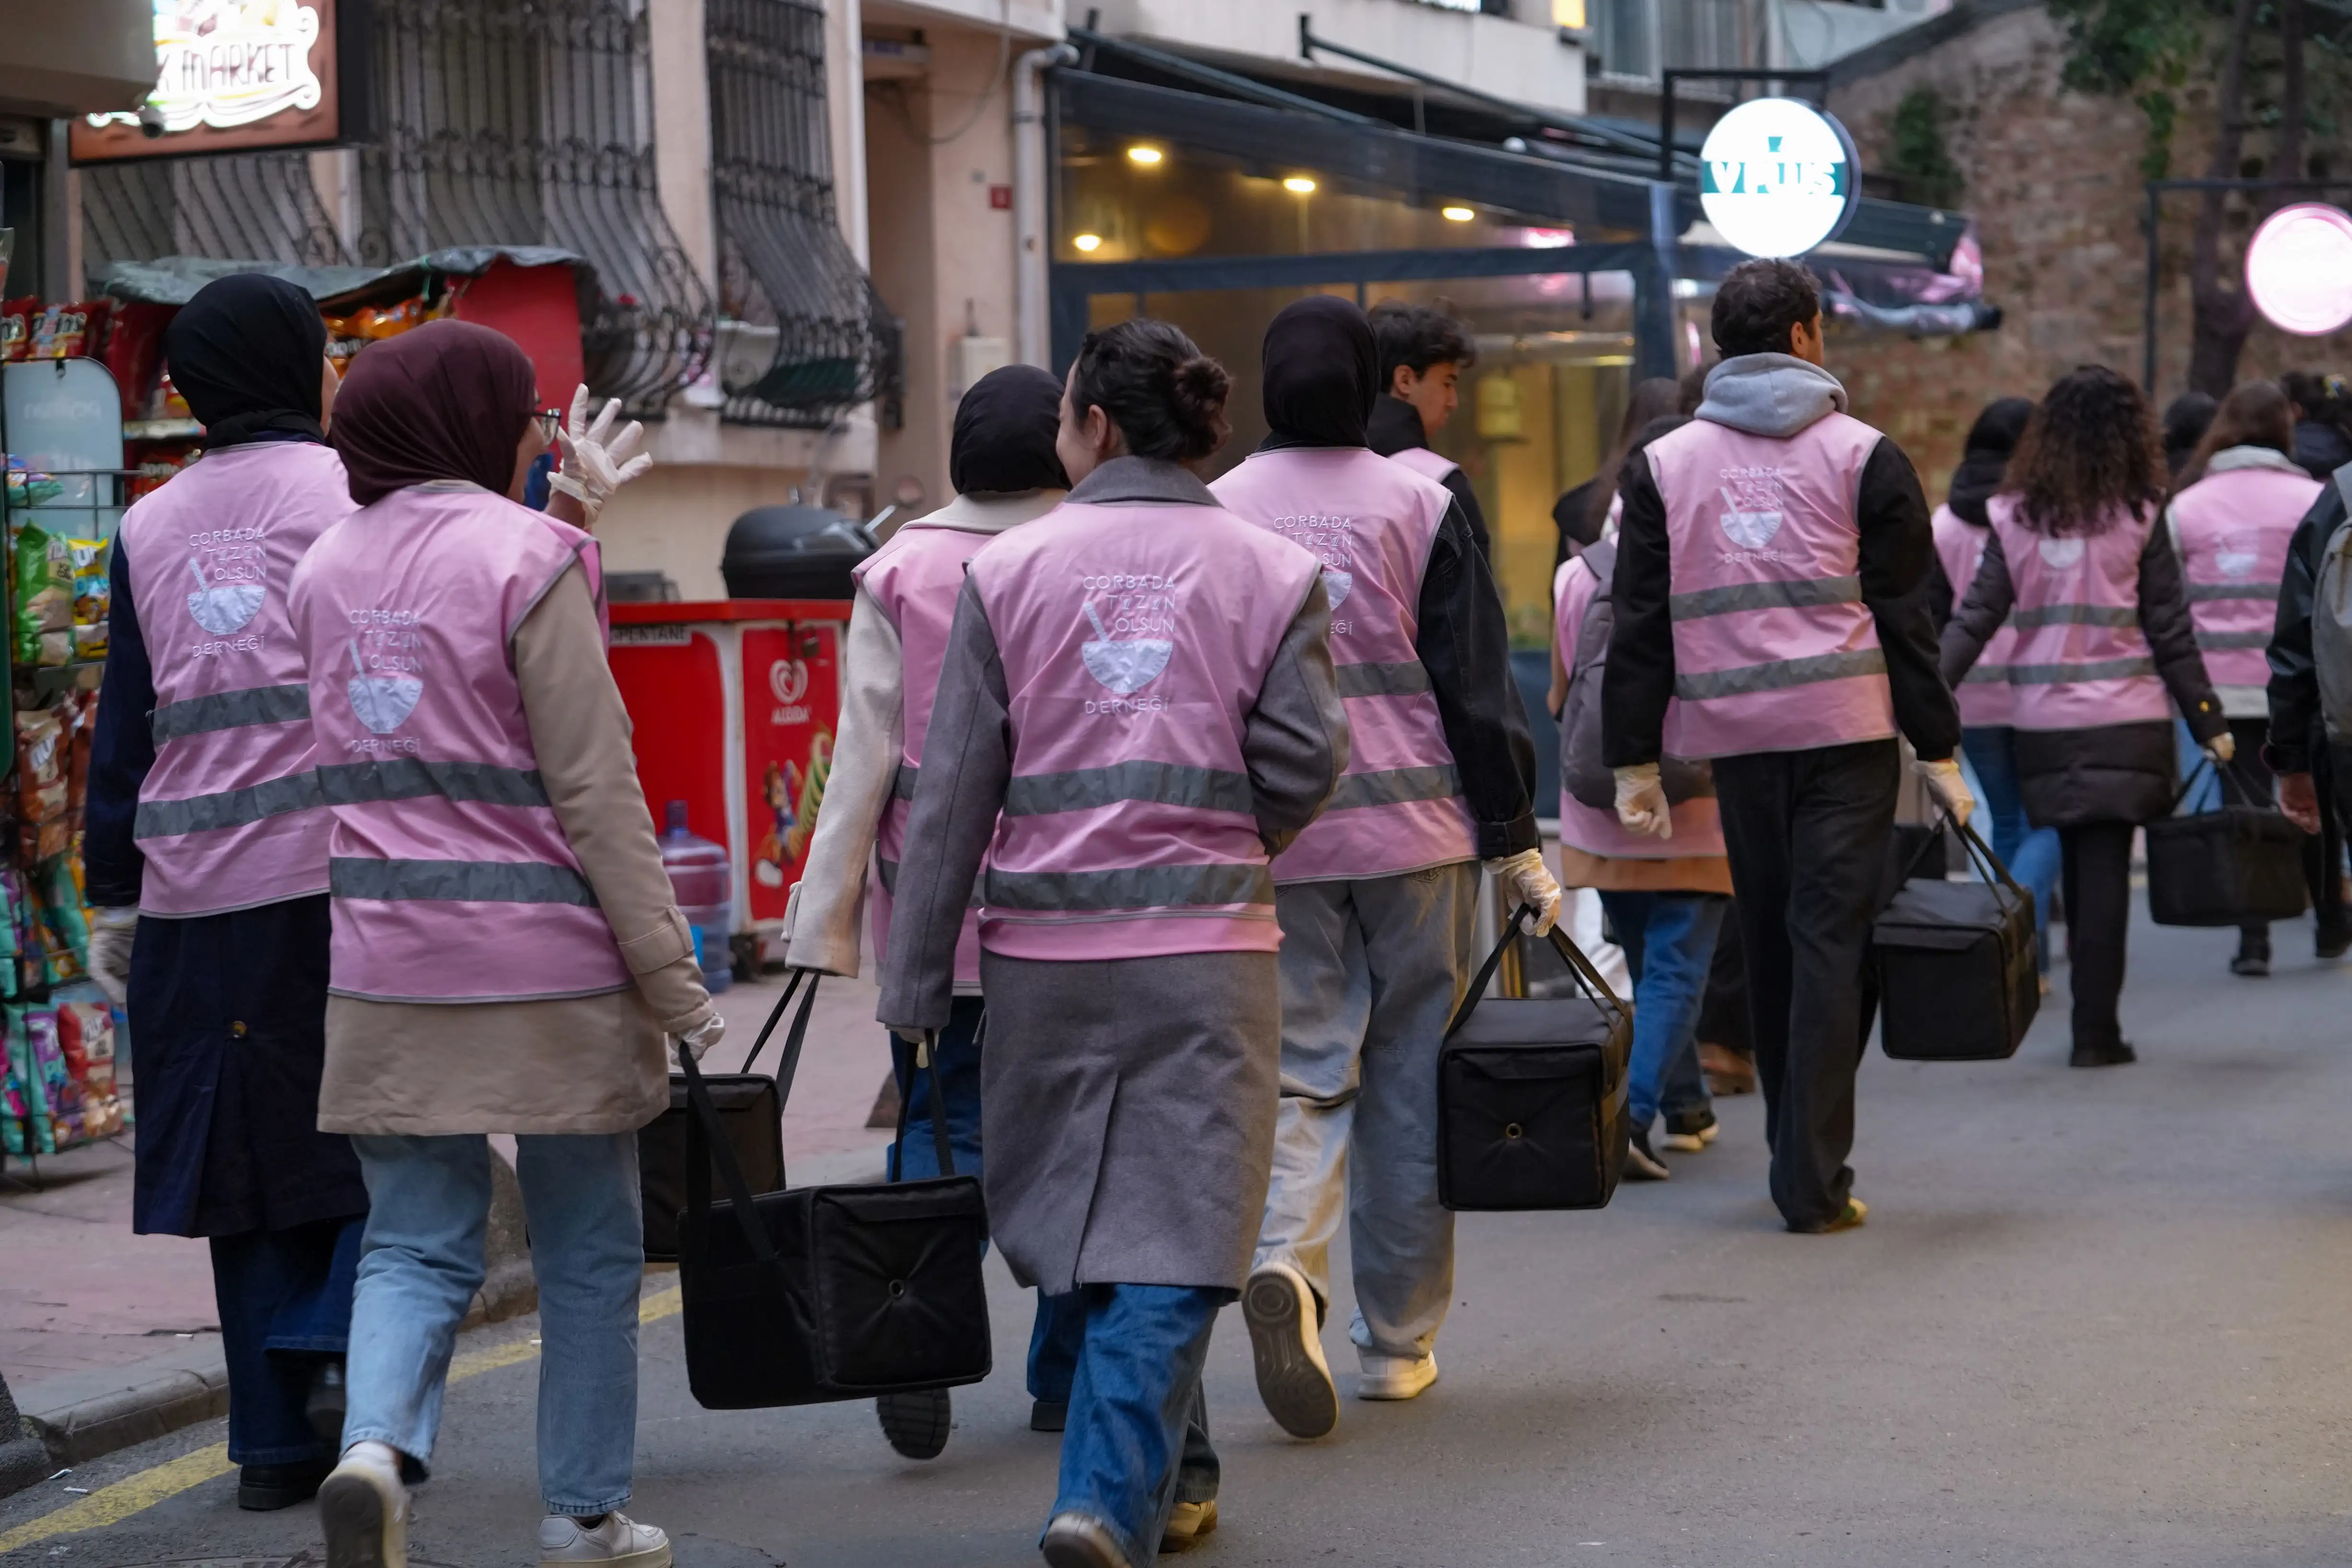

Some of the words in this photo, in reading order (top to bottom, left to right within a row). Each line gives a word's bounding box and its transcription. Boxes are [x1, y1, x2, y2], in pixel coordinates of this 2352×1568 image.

[182, 42, 296, 92] MARKET
[1274, 515, 1352, 533] ÇORBADA
[189, 528, 266, 550] ÇORBADA
[214, 566, 267, 581] OLSUN
[1115, 617, 1175, 633] OLSUN
[193, 635, 265, 657] DERNEĞİ
[369, 654, 423, 672] OLSUN
[1085, 695, 1170, 714] DERNEĞİ
